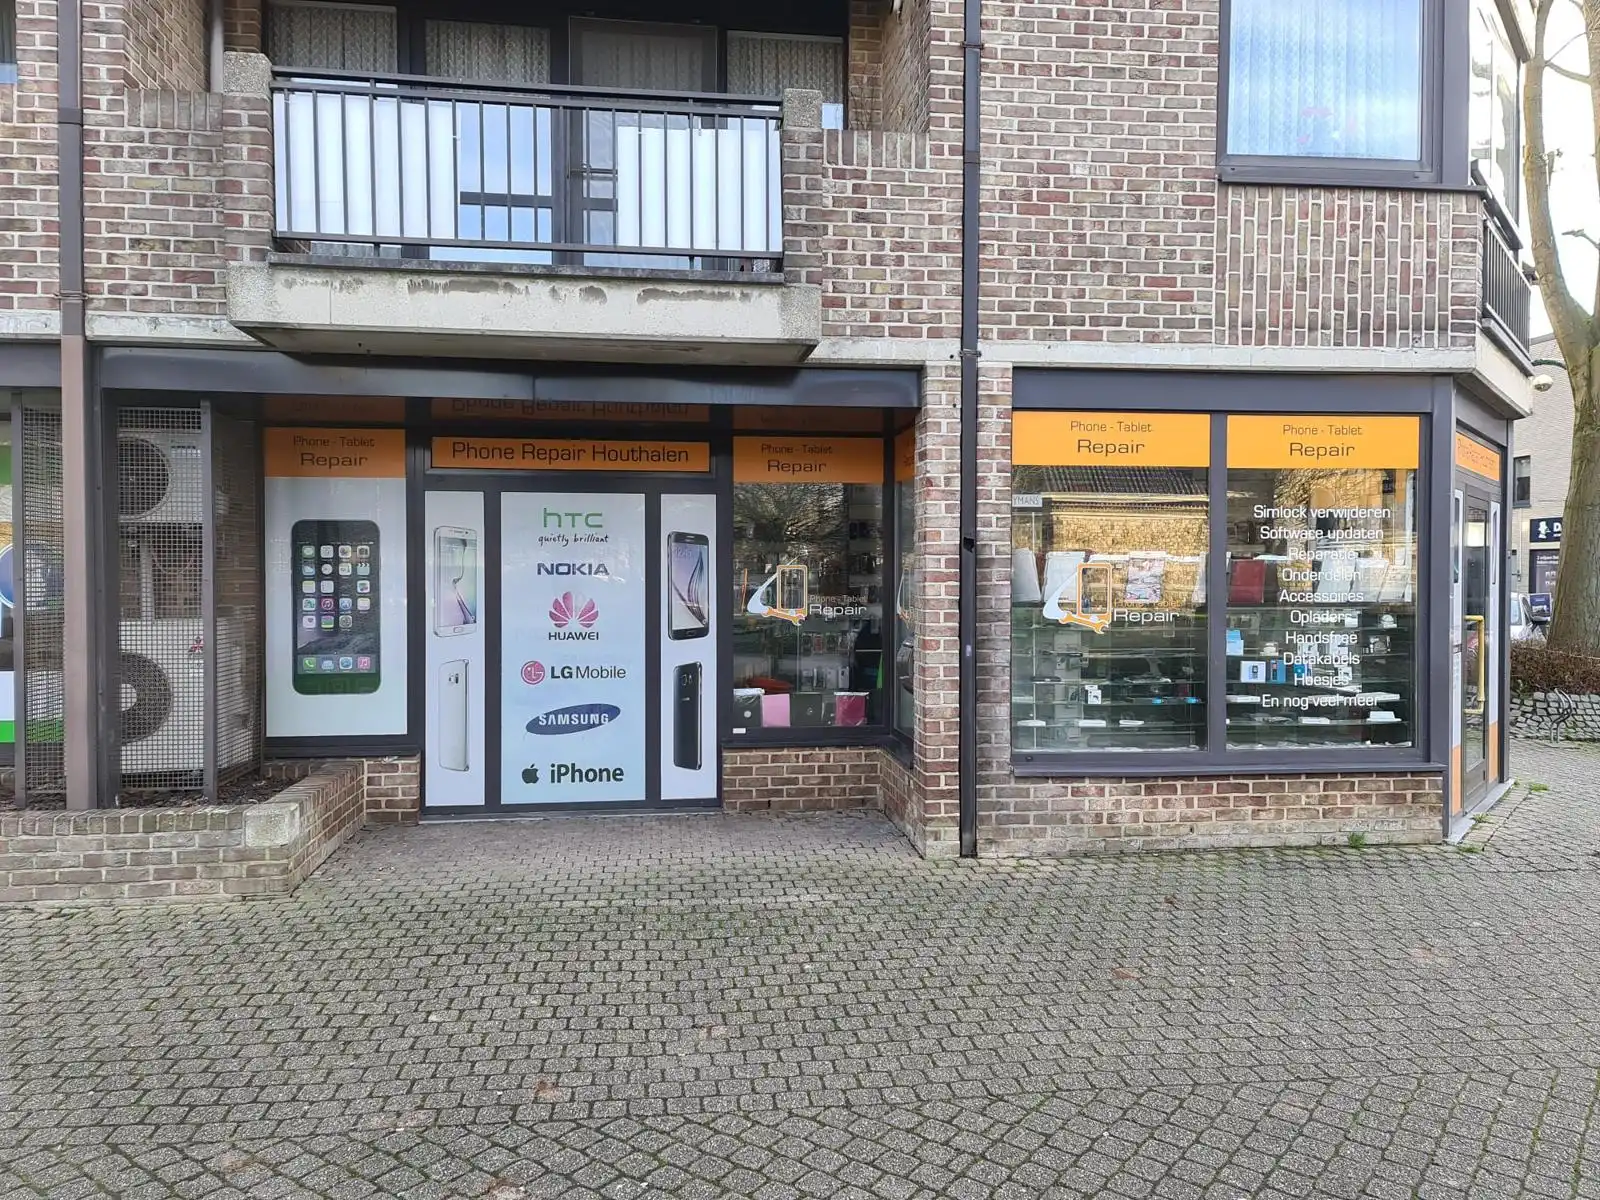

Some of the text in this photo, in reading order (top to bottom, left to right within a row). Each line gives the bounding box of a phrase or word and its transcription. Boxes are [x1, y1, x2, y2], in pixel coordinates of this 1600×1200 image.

[1071, 420, 1107, 432] Phone
[1116, 421, 1152, 433] Tablet
[1283, 424, 1318, 436] Phone
[1327, 424, 1362, 436] Tablet
[293, 435, 330, 447] Phone
[339, 436, 375, 448] Tablet
[761, 443, 793, 455] Phone
[802, 444, 833, 455] Tablet
[1077, 439, 1145, 457] Repair
[452, 442, 689, 465] Phone Repair Houthalen
[1289, 442, 1355, 460] Repair
[300, 452, 368, 469] Repair
[767, 459, 827, 476] Repair
[1253, 504, 1391, 521] Simlock verwijderen
[538, 532, 609, 547] quietly brilliant
[1260, 526, 1384, 542] Software updaten
[537, 562, 610, 576] NOKIA
[1282, 568, 1362, 582] Onderdelen
[1279, 589, 1364, 602] Accessoires
[809, 603, 867, 618] Repair
[1113, 608, 1180, 625] Repair
[1290, 610, 1353, 626] Opladers
[548, 631, 599, 641] HUAWEI
[1285, 631, 1358, 644] Handsfree
[1283, 652, 1361, 665] Datakabels
[550, 665, 626, 679] LG Mobile
[1294, 673, 1350, 688] Hoesjes
[1262, 693, 1379, 711] En nog veel meer
[538, 713, 609, 726] SAMSUNG
[550, 762, 625, 783] iPhone
